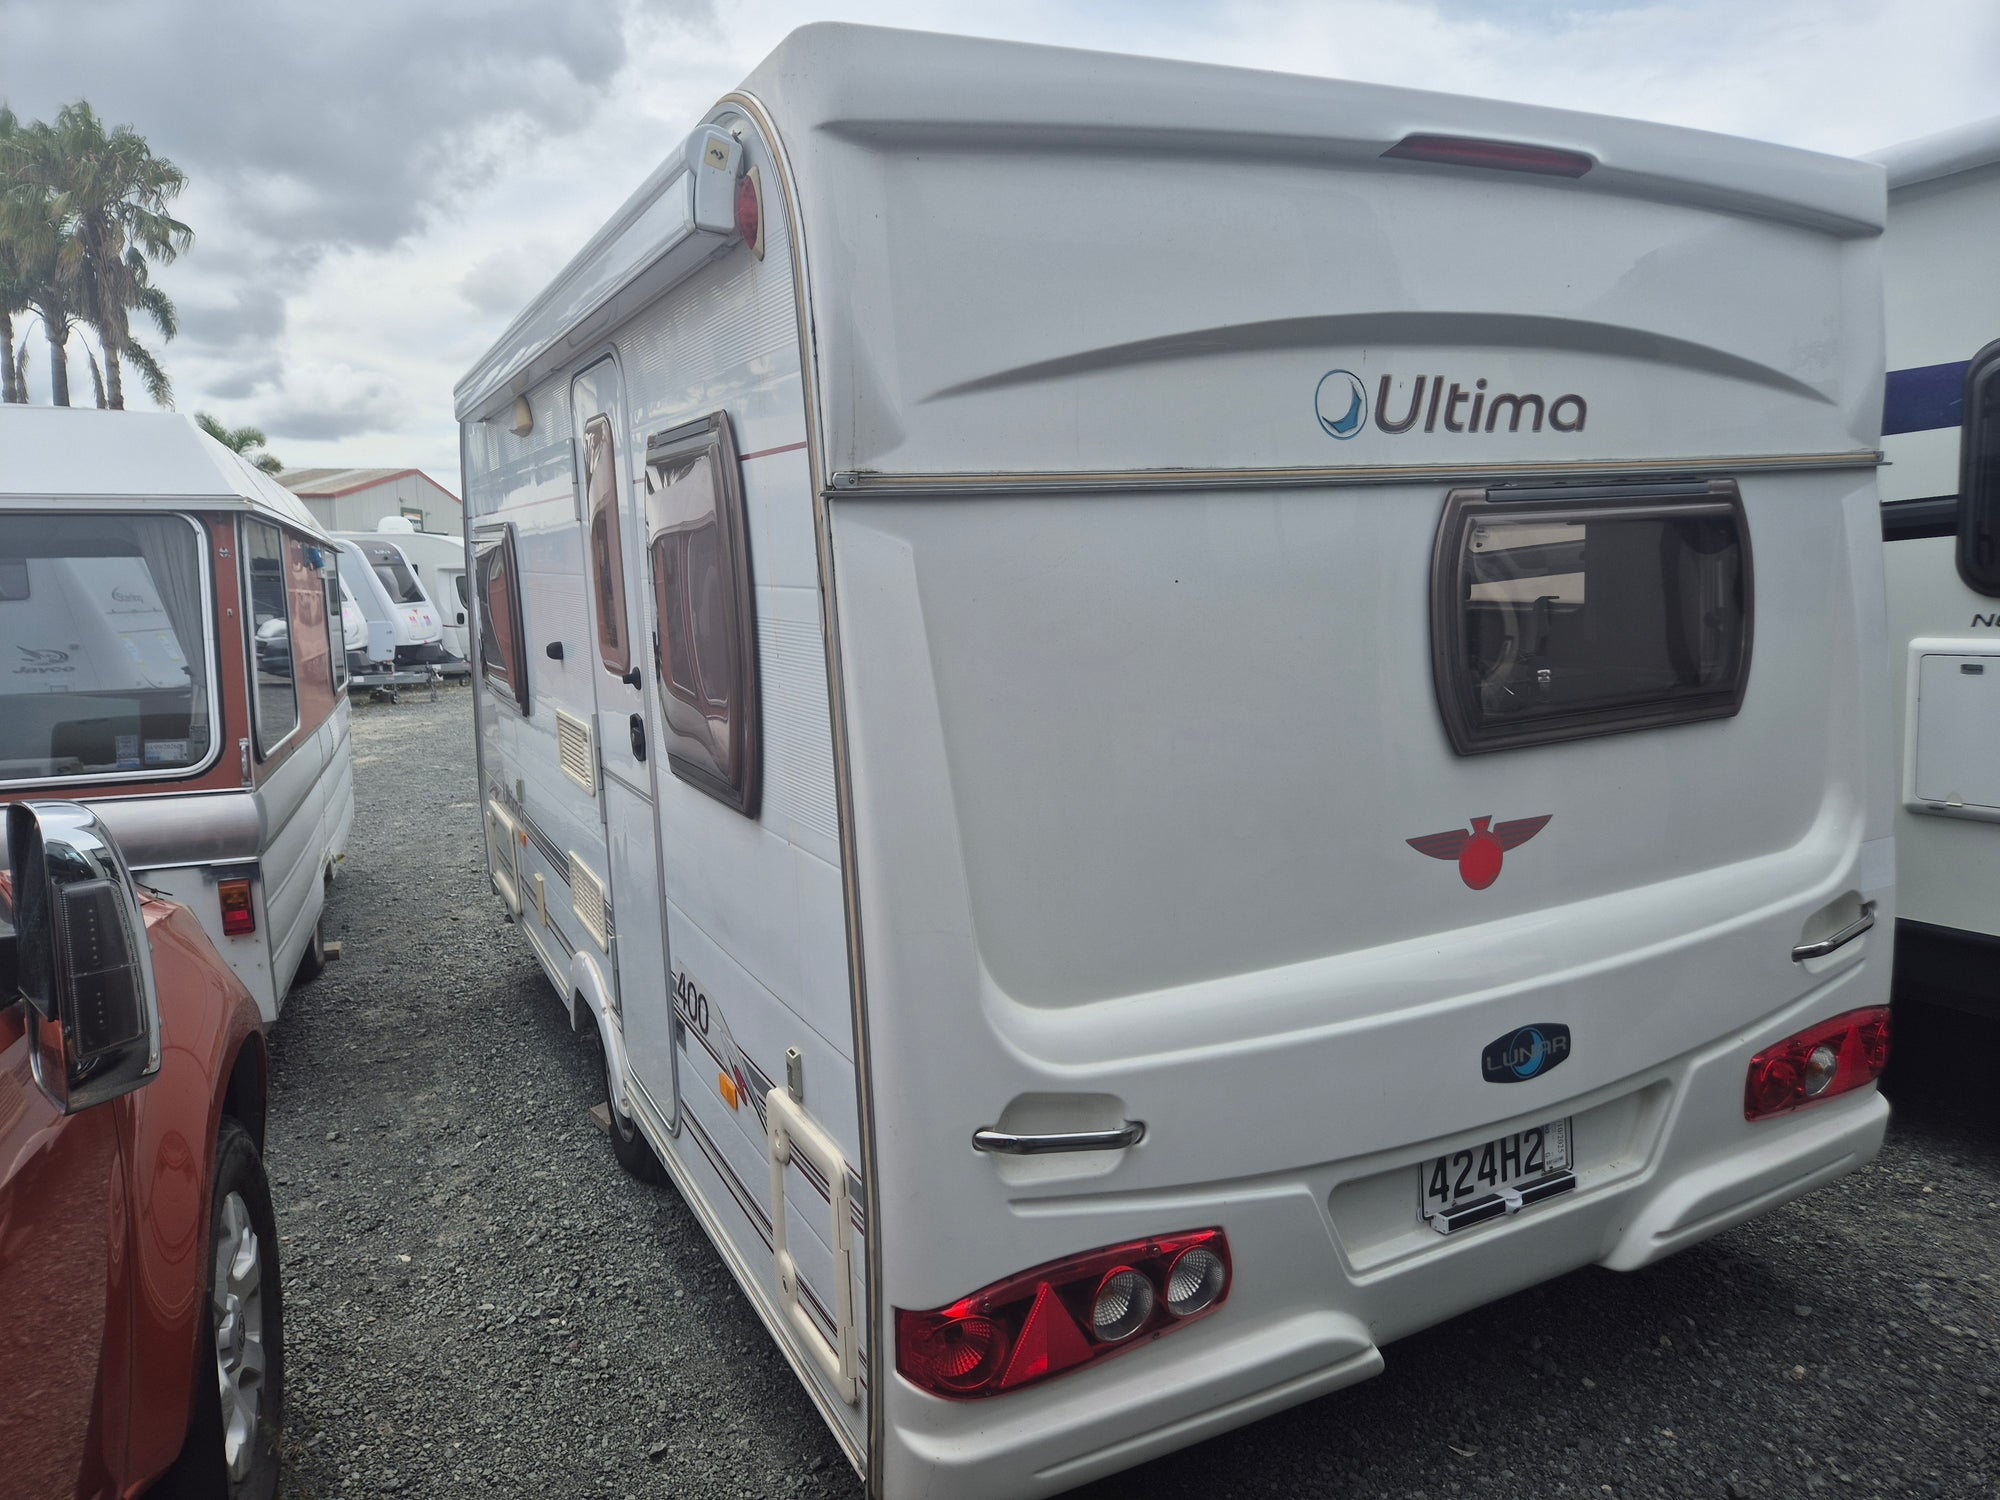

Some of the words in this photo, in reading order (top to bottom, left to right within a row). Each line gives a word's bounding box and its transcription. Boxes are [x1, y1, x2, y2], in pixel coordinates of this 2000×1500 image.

[1375, 373, 1587, 434] Ultima
[12, 665, 76, 674] Jayco
[677, 972, 709, 1036] 400
[1486, 1035, 1567, 1071] LUNAR
[1428, 1126, 1544, 1204] 424H2
